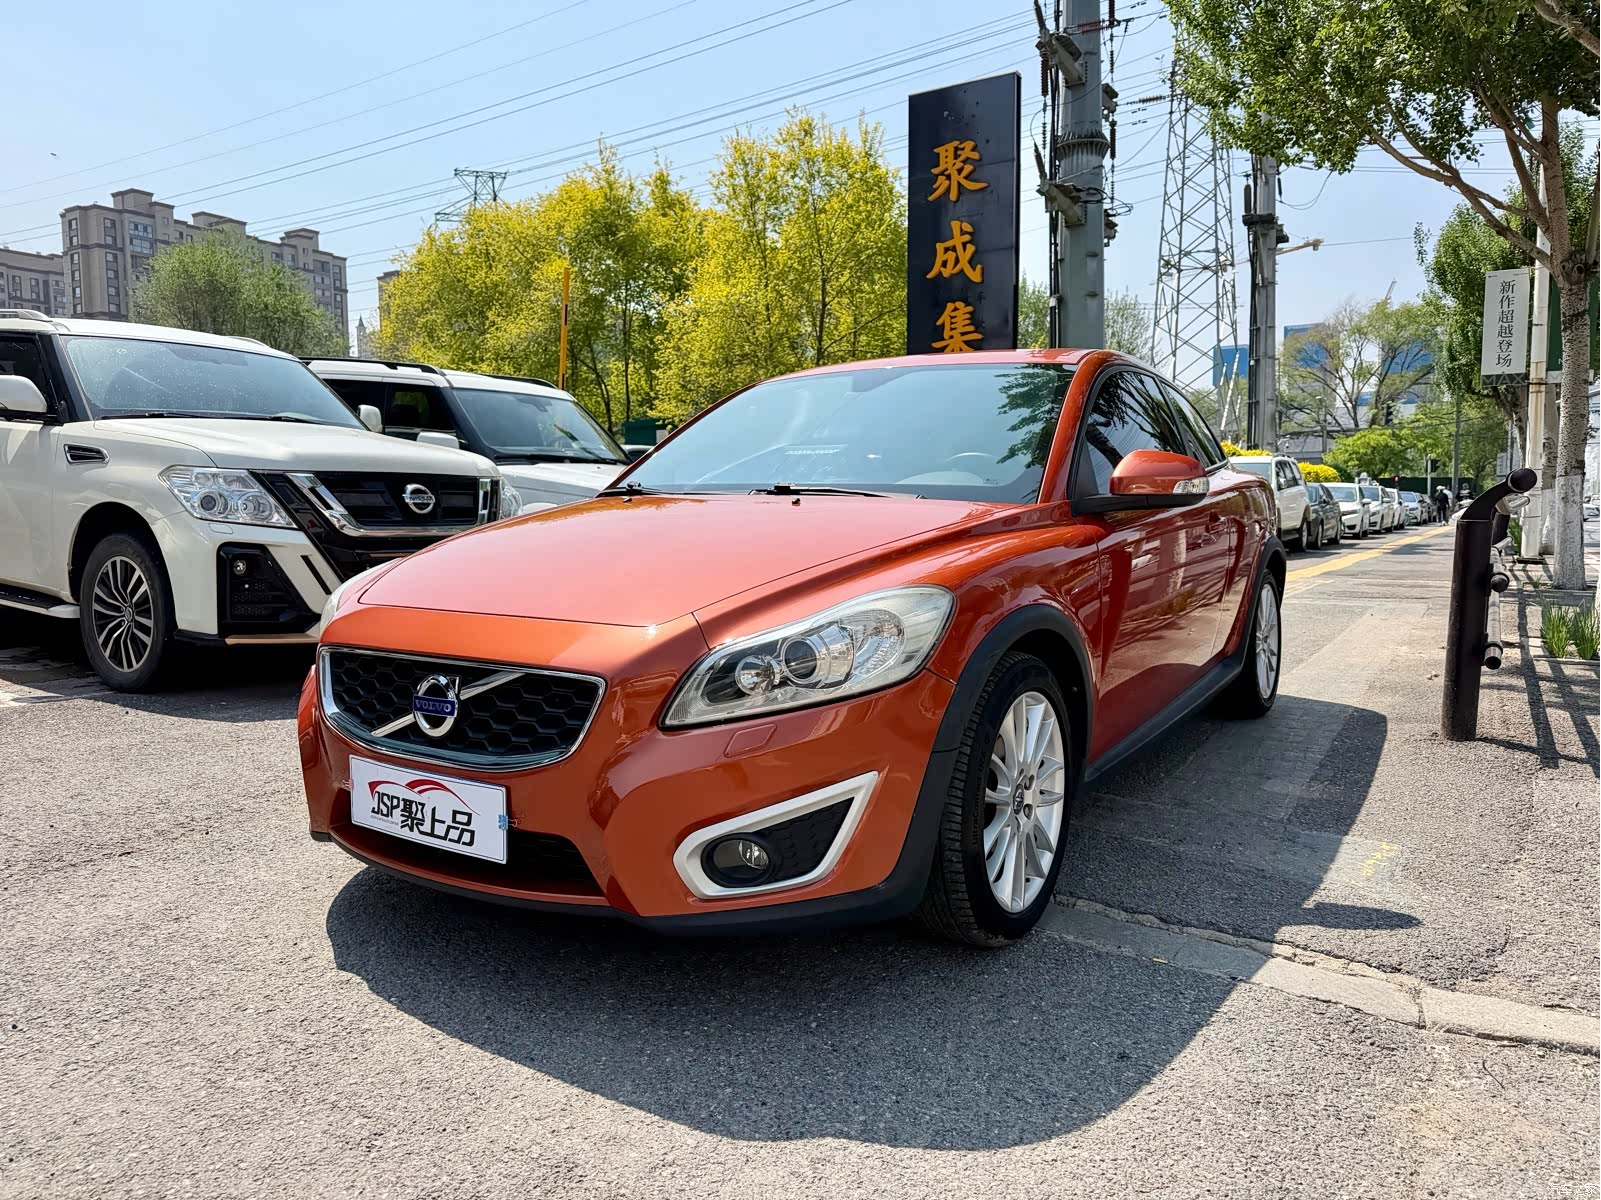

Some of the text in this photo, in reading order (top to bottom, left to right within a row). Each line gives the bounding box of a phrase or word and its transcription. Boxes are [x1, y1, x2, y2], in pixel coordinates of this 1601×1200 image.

[926, 139, 989, 353] 聚成集
[1495, 279, 1516, 368] 新作超越登场
[414, 699, 452, 713] VOLVO
